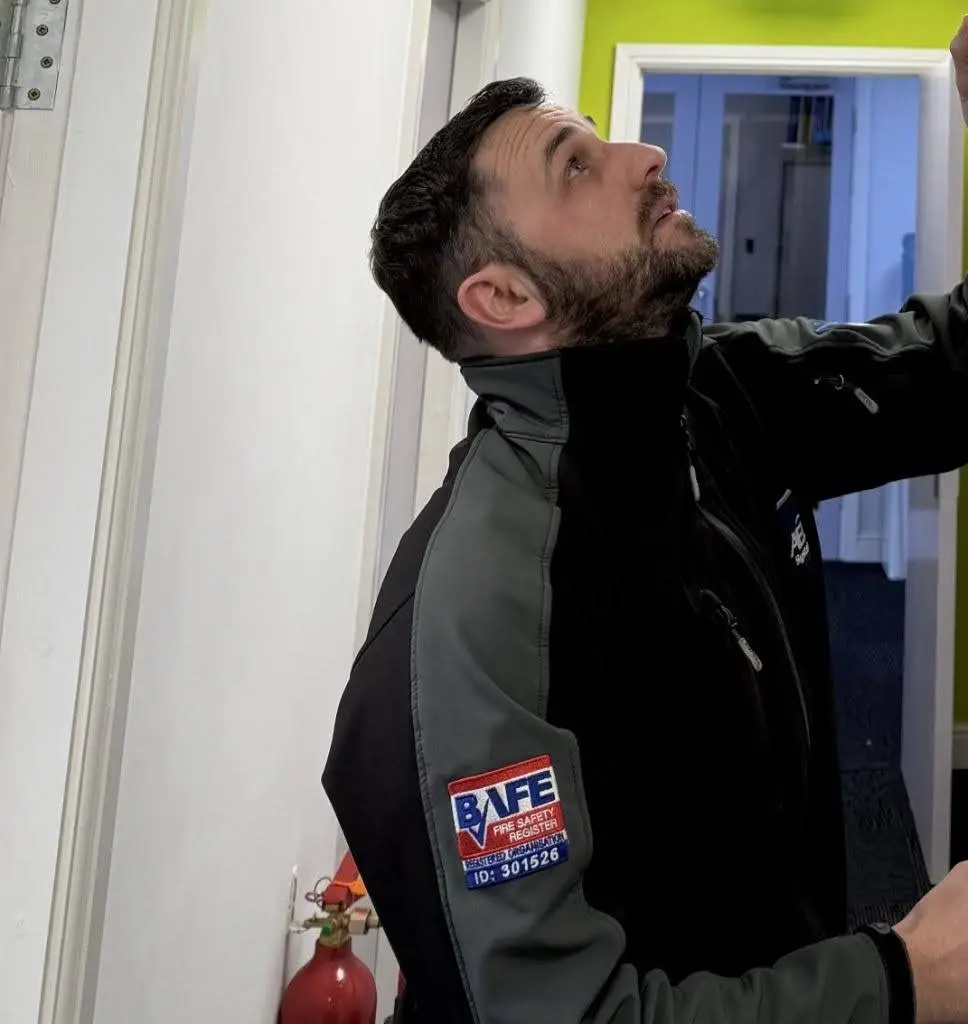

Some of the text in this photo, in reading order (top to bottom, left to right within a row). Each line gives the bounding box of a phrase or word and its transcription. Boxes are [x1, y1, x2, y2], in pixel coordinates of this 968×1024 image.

[455, 770, 555, 845] BAFE
[493, 809, 556, 836] FIRE SAFETY
[509, 819, 558, 842] REGISTER
[474, 847, 560, 885] ID: 301526
